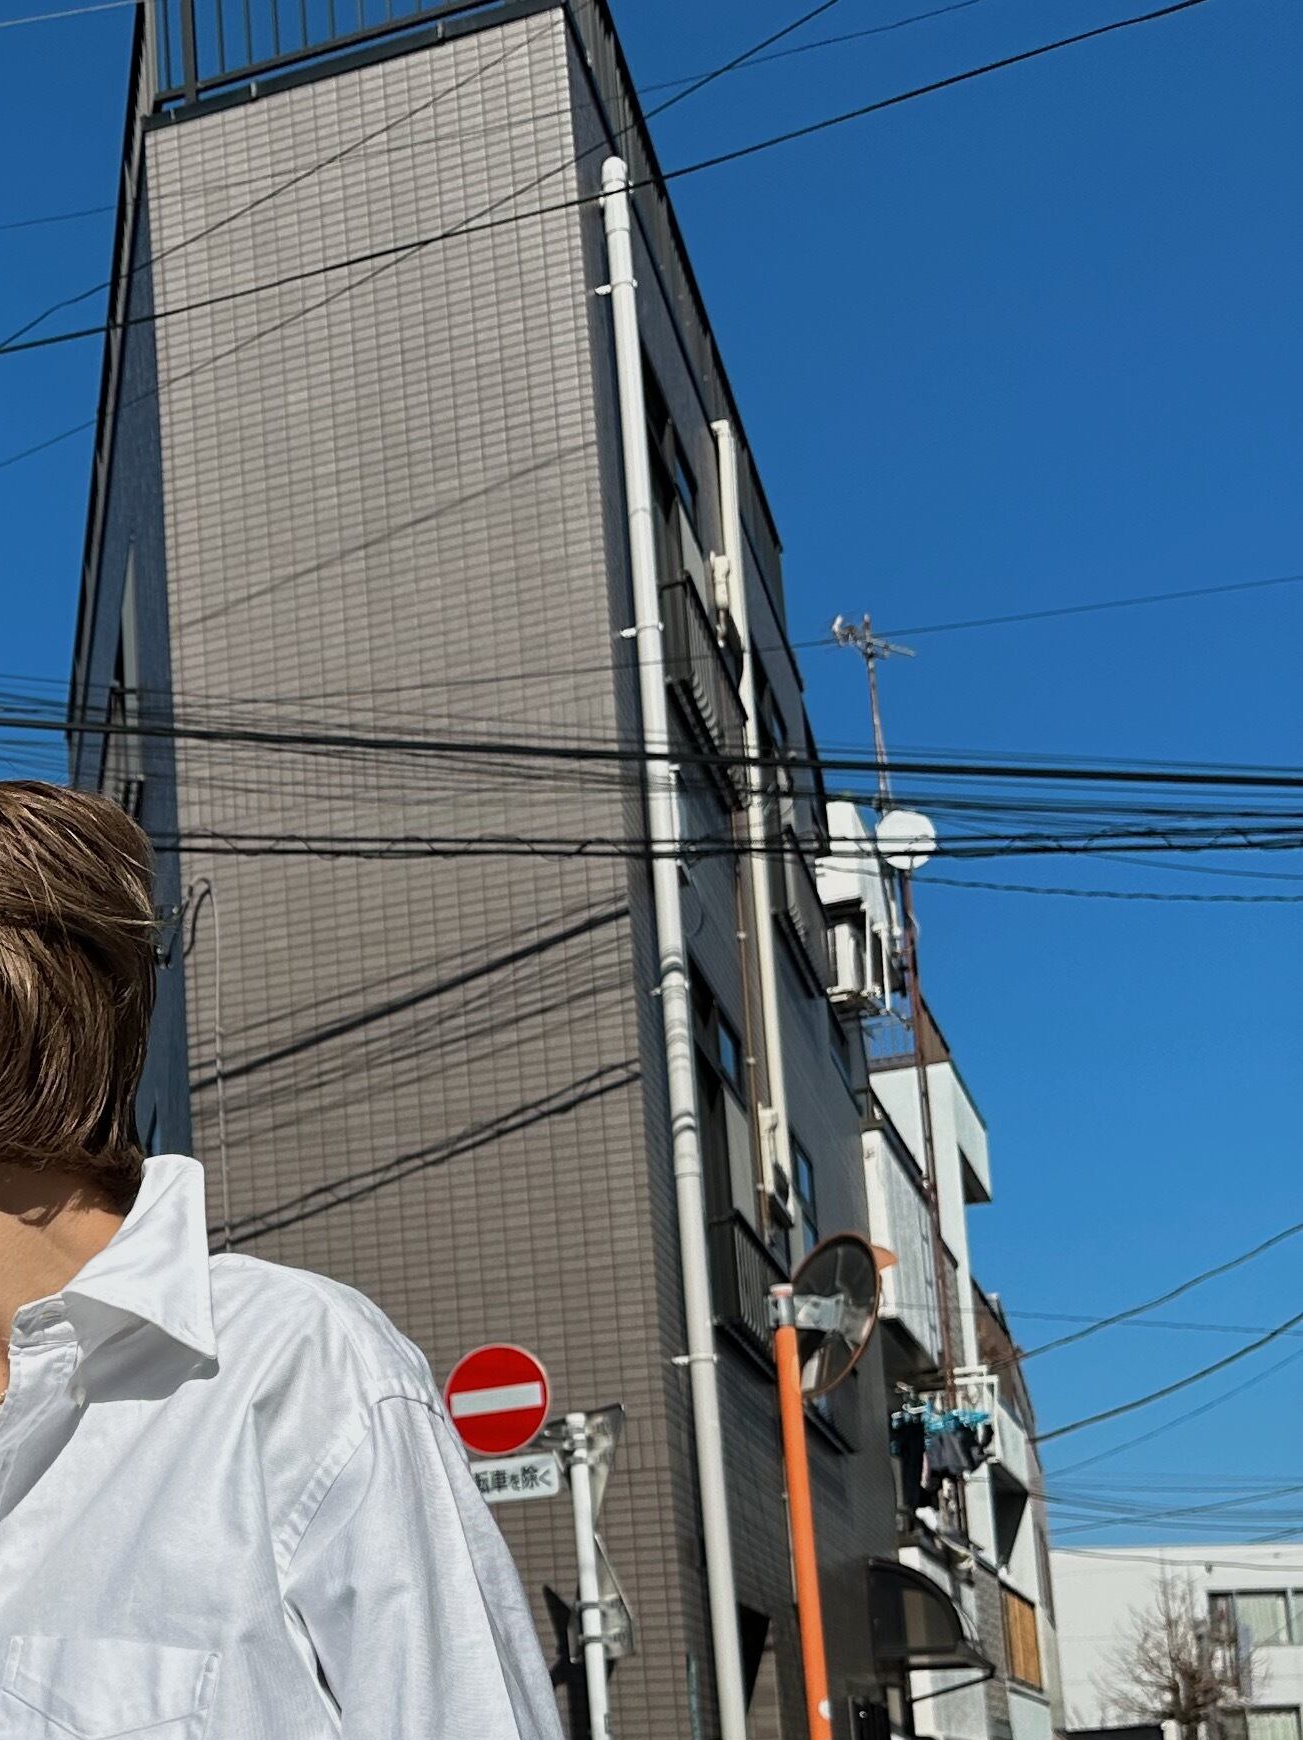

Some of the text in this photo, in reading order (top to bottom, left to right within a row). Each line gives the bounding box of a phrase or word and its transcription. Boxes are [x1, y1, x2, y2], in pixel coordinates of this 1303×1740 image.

[474, 1465, 552, 1494] 転車を除く
